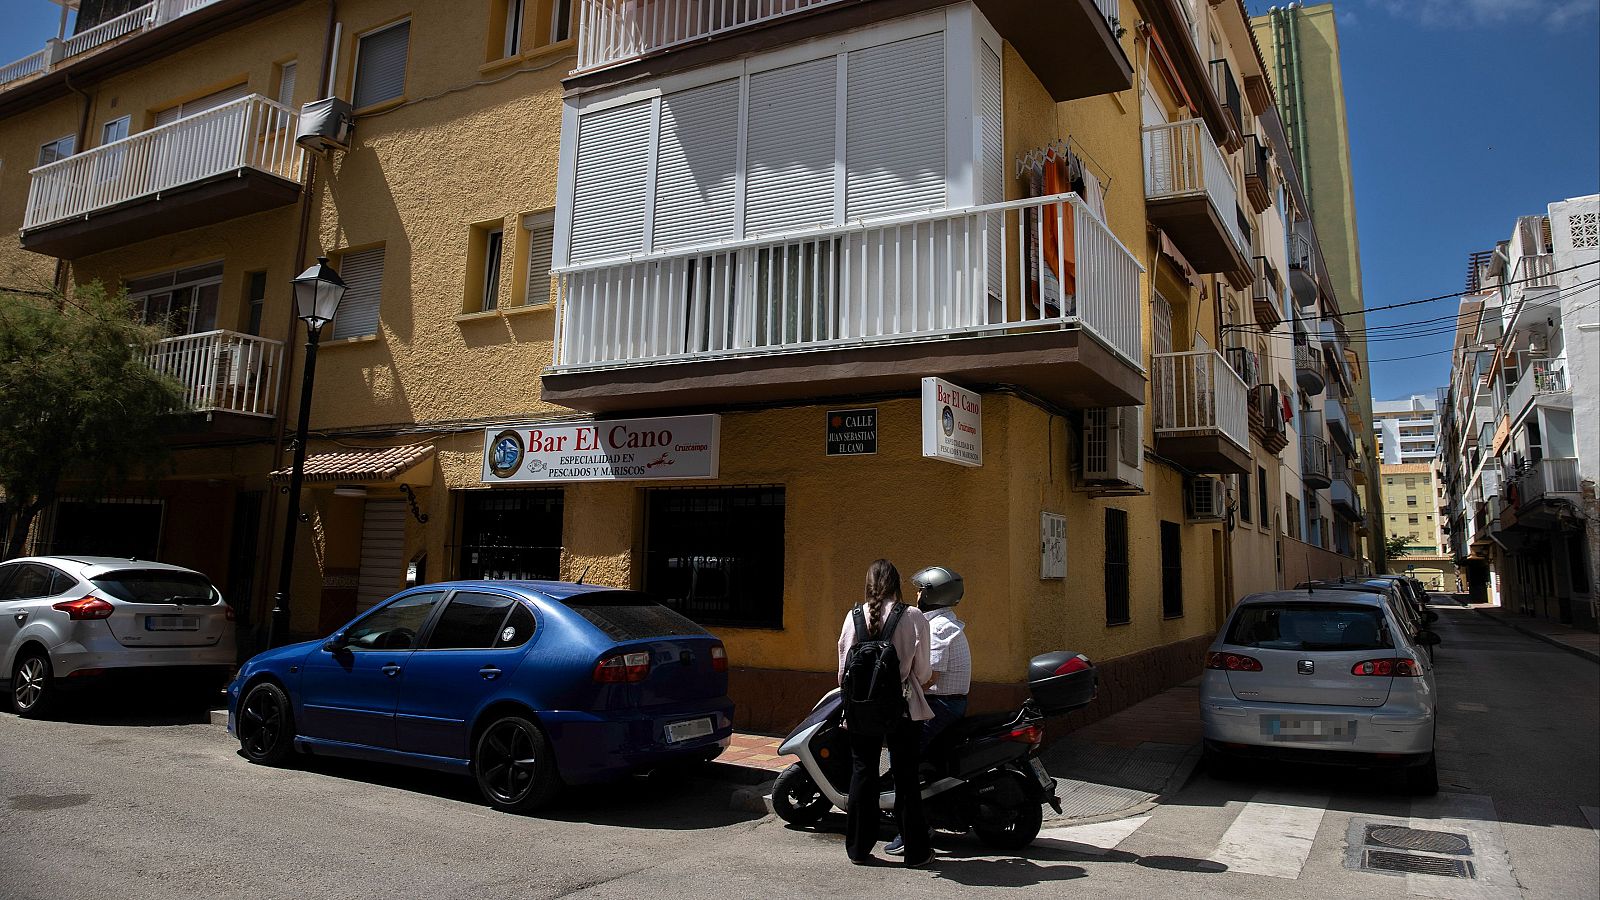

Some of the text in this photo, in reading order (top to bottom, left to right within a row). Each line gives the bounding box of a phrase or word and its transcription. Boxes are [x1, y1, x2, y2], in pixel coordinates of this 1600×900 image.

[937, 384, 979, 415] Bar El Cano
[845, 415, 873, 428] CALLE
[527, 425, 673, 453] Bar El Cano
[828, 432, 843, 442] JUAN
[674, 444, 708, 452] Cruzcampo
[839, 442, 864, 453] EL CANO
[560, 453, 635, 465] ESPECIALIDAD EN
[548, 465, 646, 477] PESCADOS Y MARISCOS
